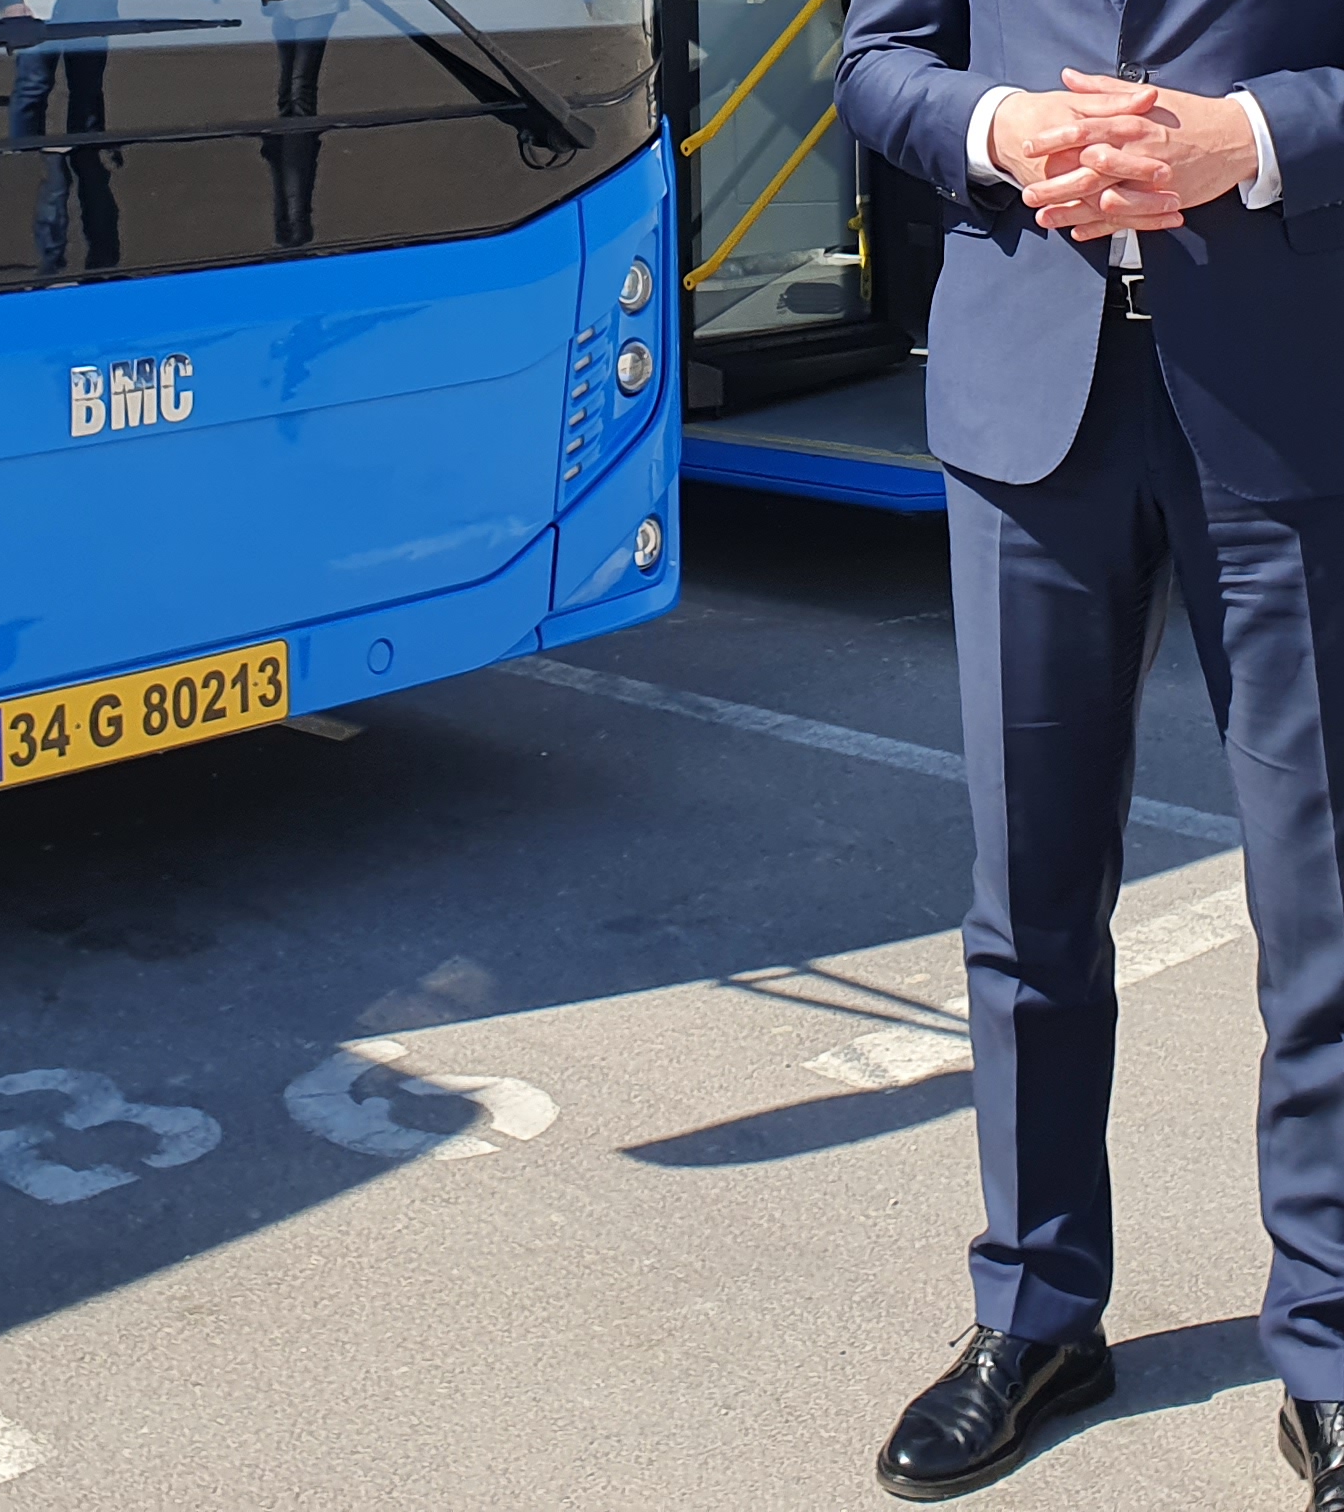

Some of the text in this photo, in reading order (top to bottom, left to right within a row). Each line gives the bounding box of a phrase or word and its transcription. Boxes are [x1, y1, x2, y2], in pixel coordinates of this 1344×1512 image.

[71, 352, 194, 437] BMC
[8, 656, 283, 767] 34 G 80213
